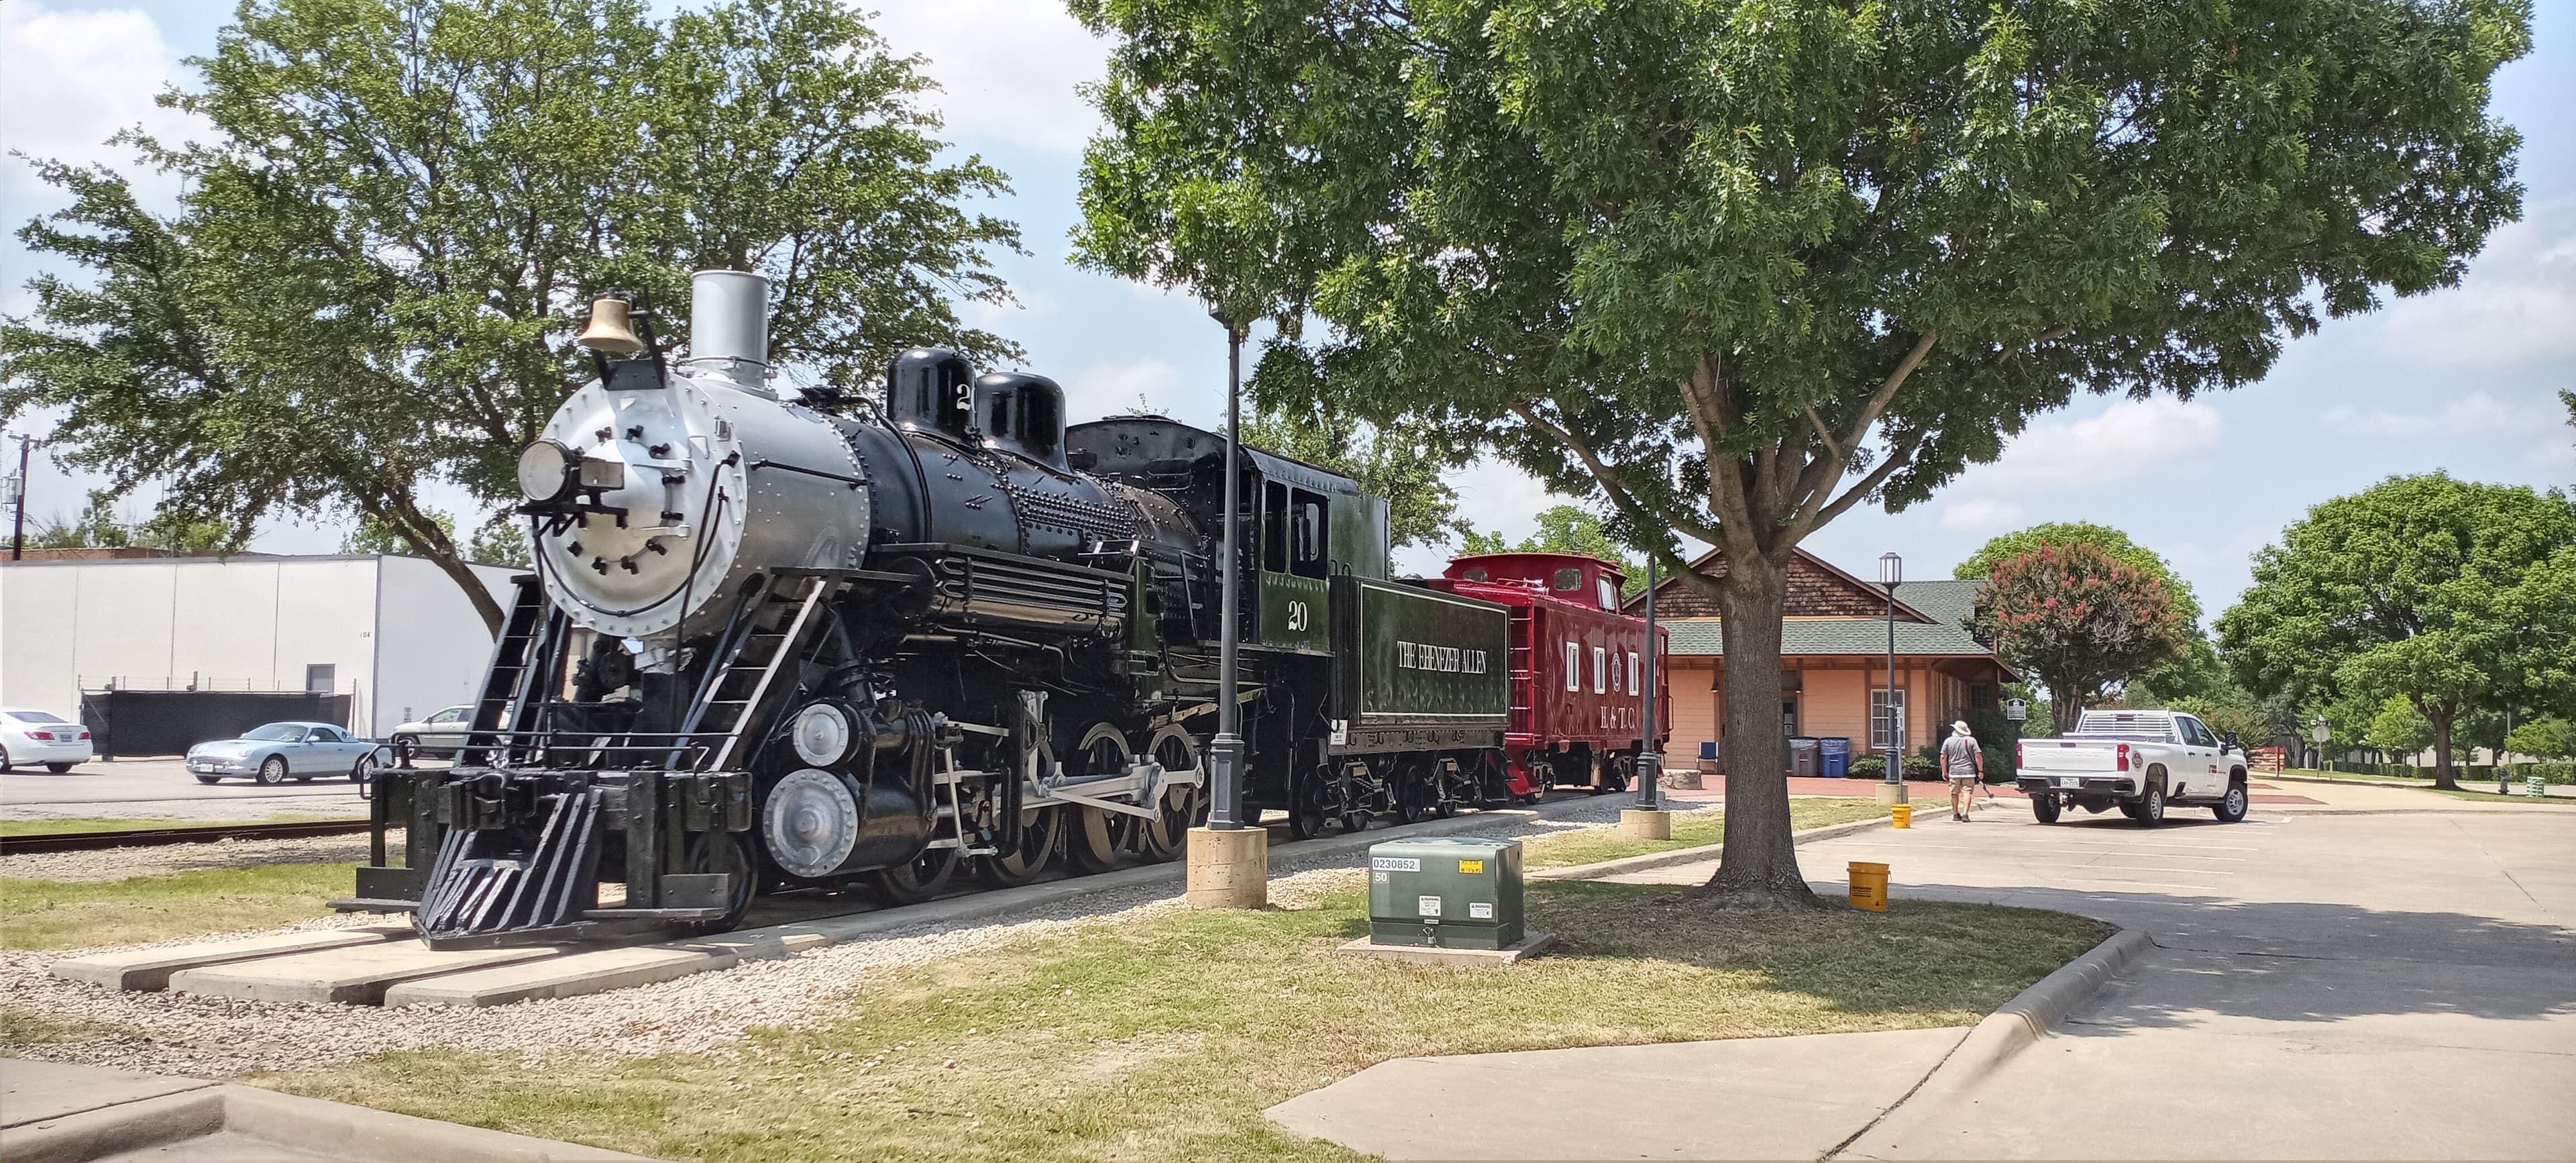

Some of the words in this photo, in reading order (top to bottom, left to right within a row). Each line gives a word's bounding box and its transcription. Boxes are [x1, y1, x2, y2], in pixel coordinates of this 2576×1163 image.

[1288, 601, 1307, 631] 20
[1397, 641, 1417, 668] THE
[1418, 644, 1459, 672] EBENEZER
[1462, 649, 1487, 674] ALLEN
[1373, 859, 1415, 869] 0230852
[1375, 872, 1387, 882] 50
